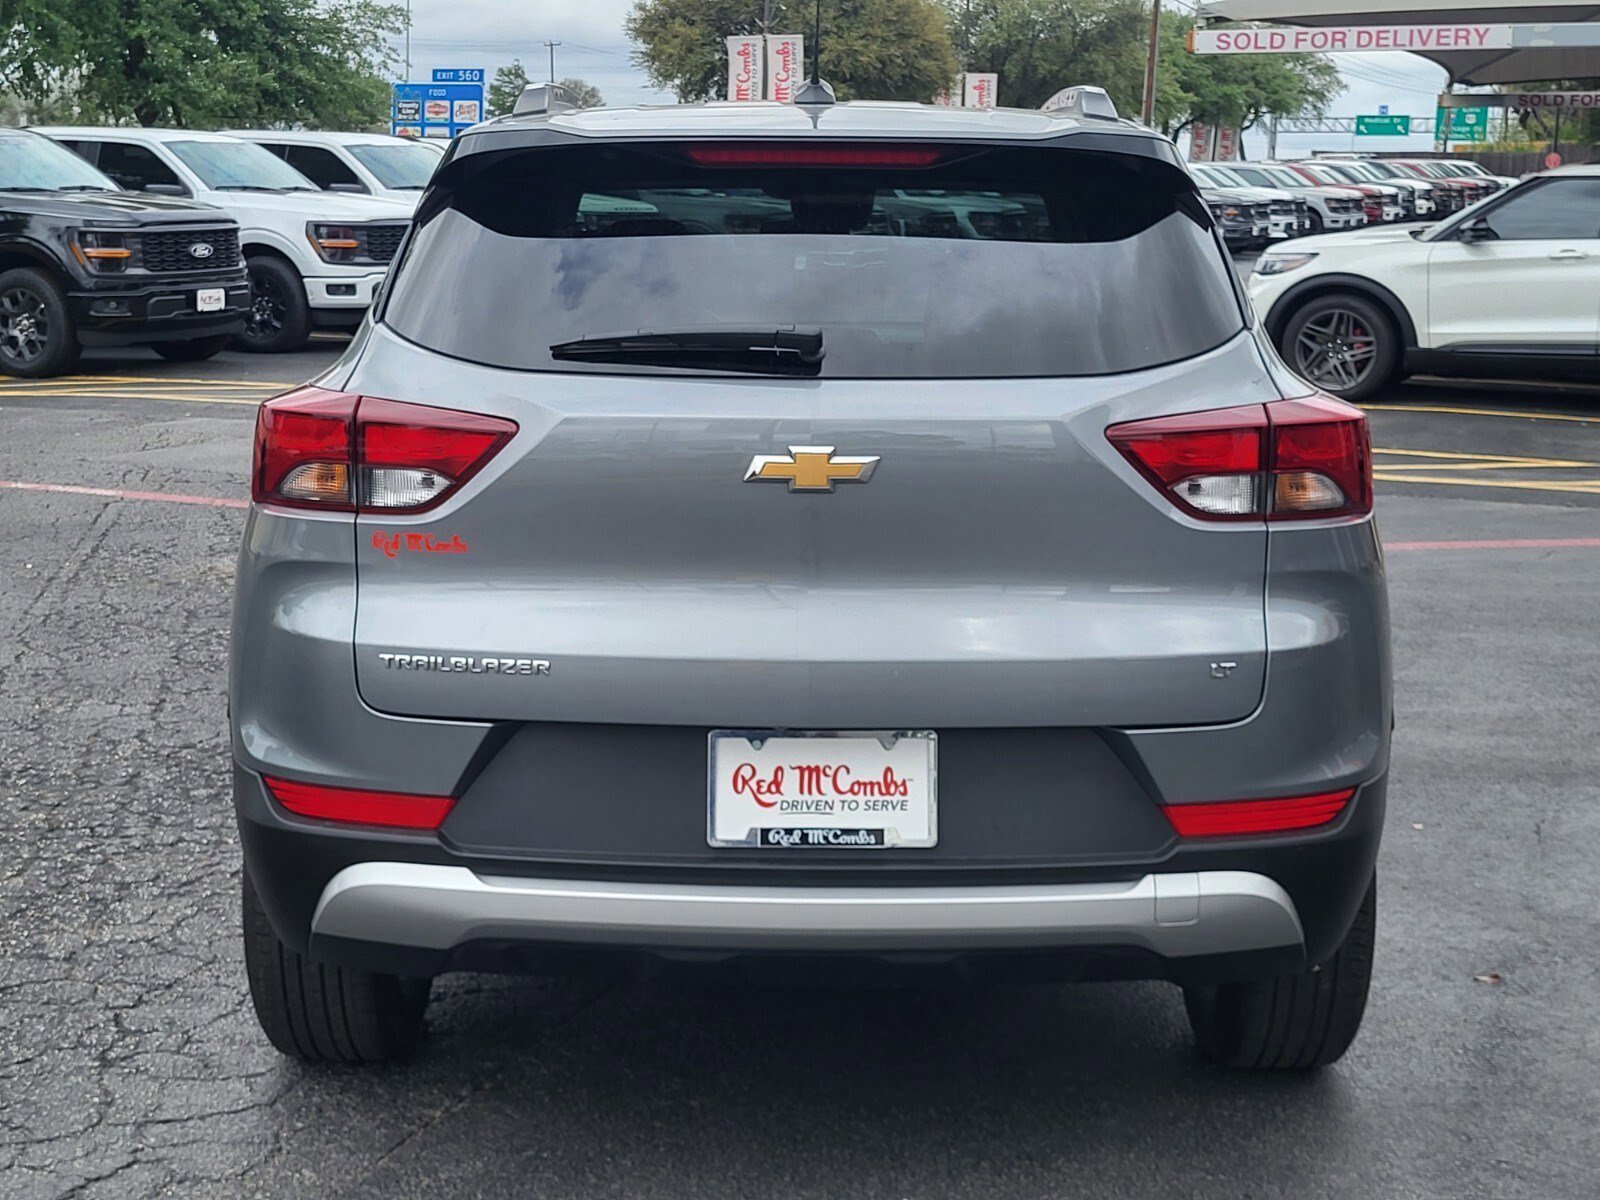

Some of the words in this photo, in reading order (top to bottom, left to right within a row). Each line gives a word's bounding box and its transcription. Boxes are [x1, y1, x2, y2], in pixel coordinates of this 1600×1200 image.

[1216, 32, 1286, 51] SOLD
[1294, 31, 1347, 49] FOR
[1356, 28, 1491, 48] DELIVERY
[437, 71, 454, 79] EXIT
[458, 70, 480, 81] 560
[1518, 95, 1564, 106] SOLD
[372, 530, 400, 559] Red
[378, 653, 552, 676] TRAILBLAZER
[1210, 662, 1237, 678] LT
[732, 762, 784, 808] Red
[779, 800, 835, 811] DRIVEN
[840, 800, 860, 811] TO
[864, 800, 908, 811] SERVE
[767, 828, 802, 847] Red
[803, 829, 876, 845] McCombs
